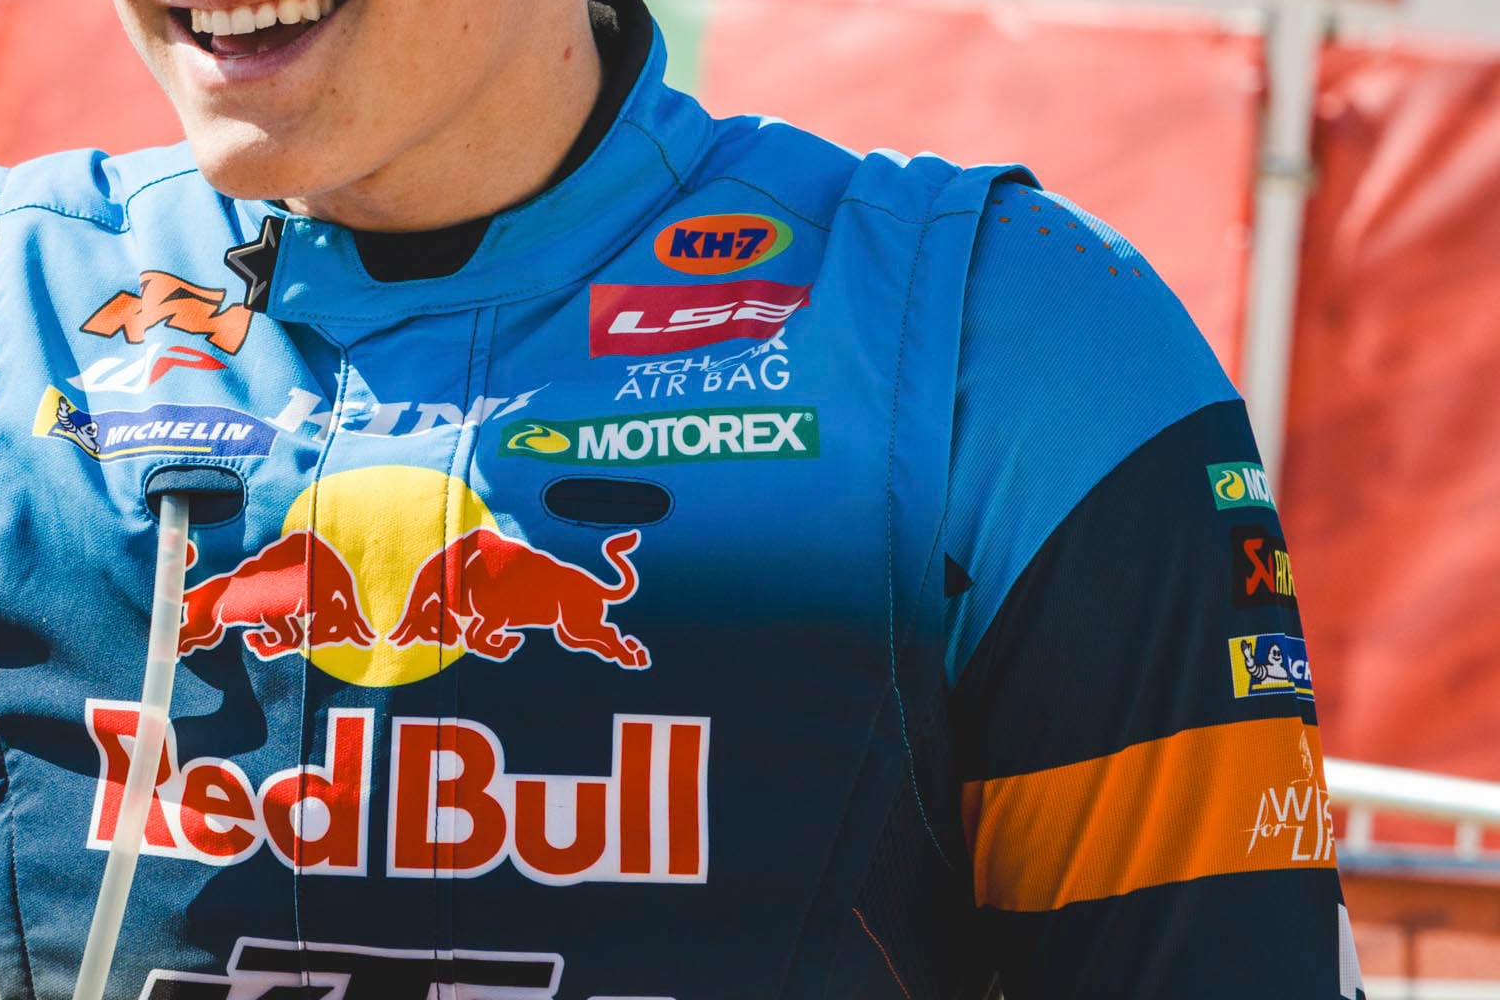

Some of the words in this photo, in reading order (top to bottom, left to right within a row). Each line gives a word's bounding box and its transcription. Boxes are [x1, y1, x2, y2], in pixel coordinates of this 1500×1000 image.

[608, 297, 804, 335] LS2
[104, 420, 254, 449] MICHELIN
[86, 699, 375, 878] Red
[387, 713, 711, 886] Bull
